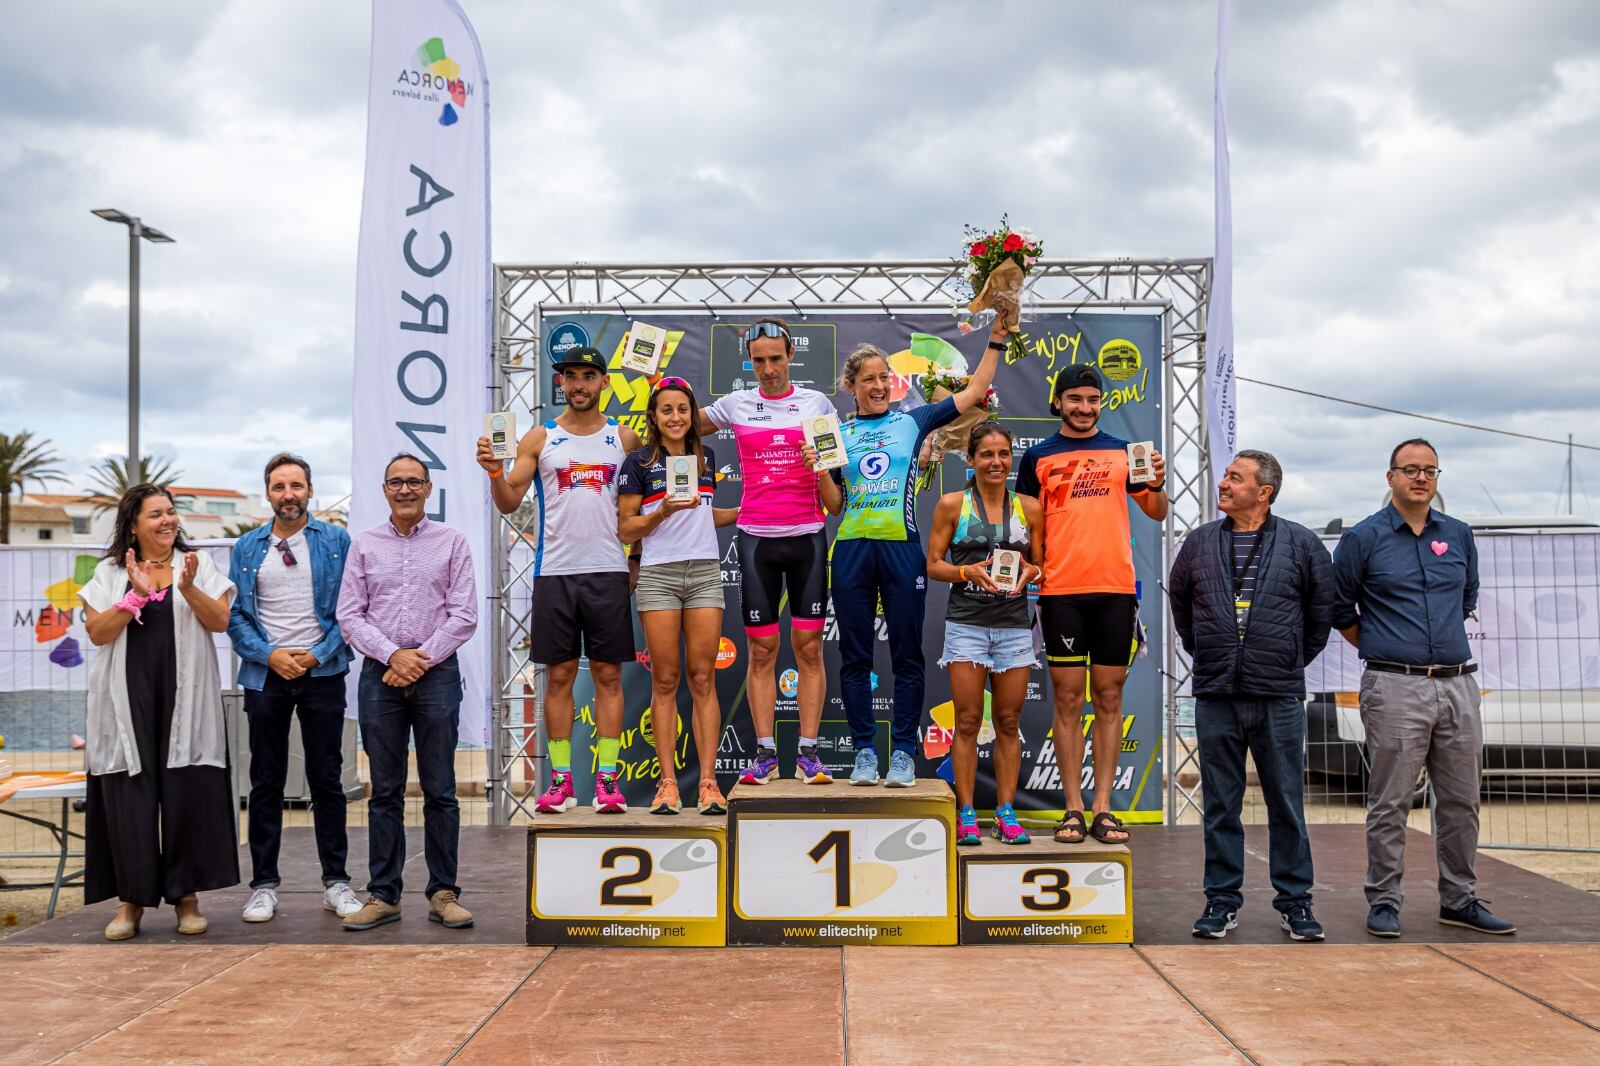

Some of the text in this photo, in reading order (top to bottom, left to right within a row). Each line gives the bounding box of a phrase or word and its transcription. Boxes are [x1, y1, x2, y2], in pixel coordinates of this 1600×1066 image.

[791, 336, 810, 346] TIB
[1100, 368, 1149, 411] eam!
[1012, 437, 1046, 448] AETI
[570, 470, 604, 484] CAMPER
[1076, 470, 1111, 481] ARTIEM
[852, 478, 900, 495] POWER
[1073, 480, 1096, 490] HALF
[1070, 488, 1111, 499] MENORCA
[616, 733, 689, 781] Drea!
[715, 758, 754, 770] RTIE
[600, 845, 653, 906] 2
[806, 829, 853, 909] 1
[1021, 867, 1072, 913] 3
[567, 924, 686, 940] www.elitechip.net
[783, 924, 903, 940] www.elitechip.net
[987, 922, 1108, 938] www.elitechip.net
